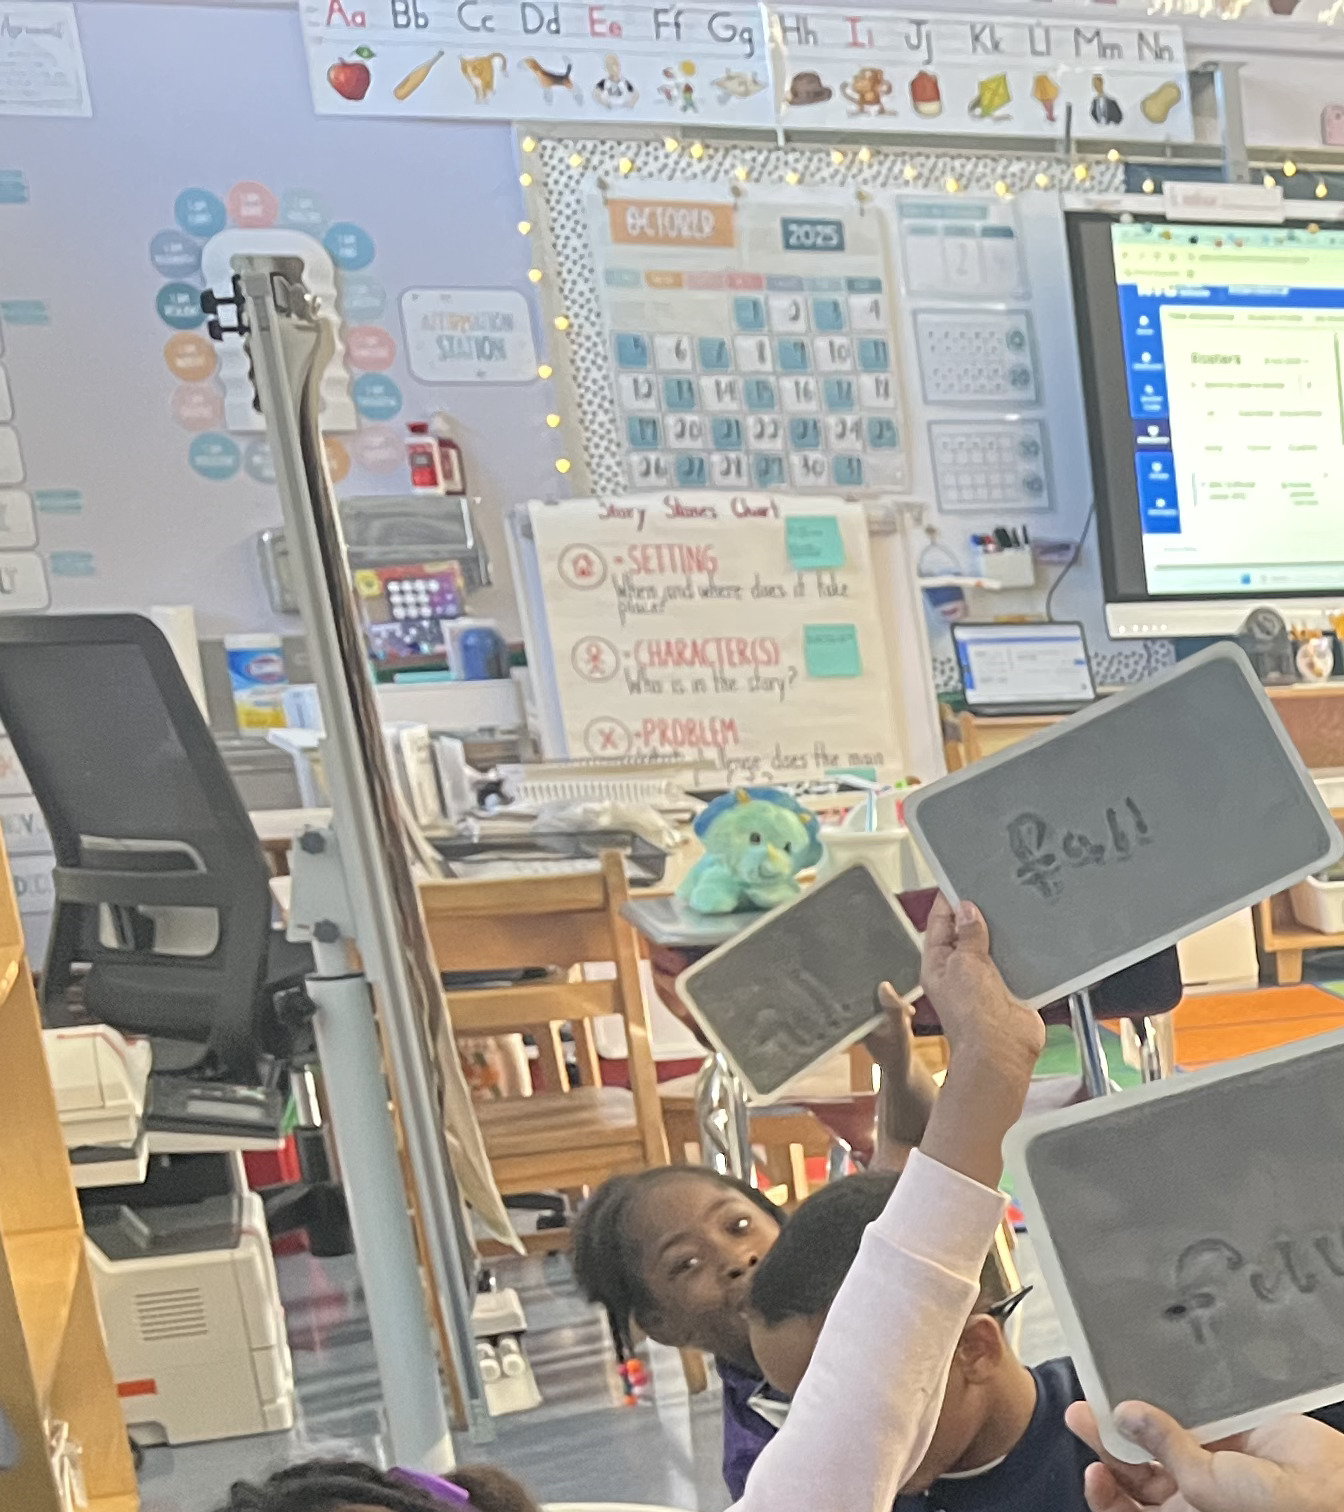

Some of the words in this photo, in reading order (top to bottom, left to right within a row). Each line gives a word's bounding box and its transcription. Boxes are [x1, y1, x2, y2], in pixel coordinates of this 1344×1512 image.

[326, 0, 366, 28] Aa
[393, 0, 429, 29] Bb
[458, 3, 495, 32] Cc
[521, 2, 560, 35] Dd
[588, 8, 623, 37] Ee
[654, 8, 683, 41] Ff
[708, 12, 755, 58] Gg
[904, 19, 933, 64] Jj
[969, 23, 1000, 53] Kk
[1074, 28, 1123, 59] Mm
[1137, 31, 1174, 61] Nn
[788, 223, 838, 246] 2025
[624, 667, 663, 695] Who
